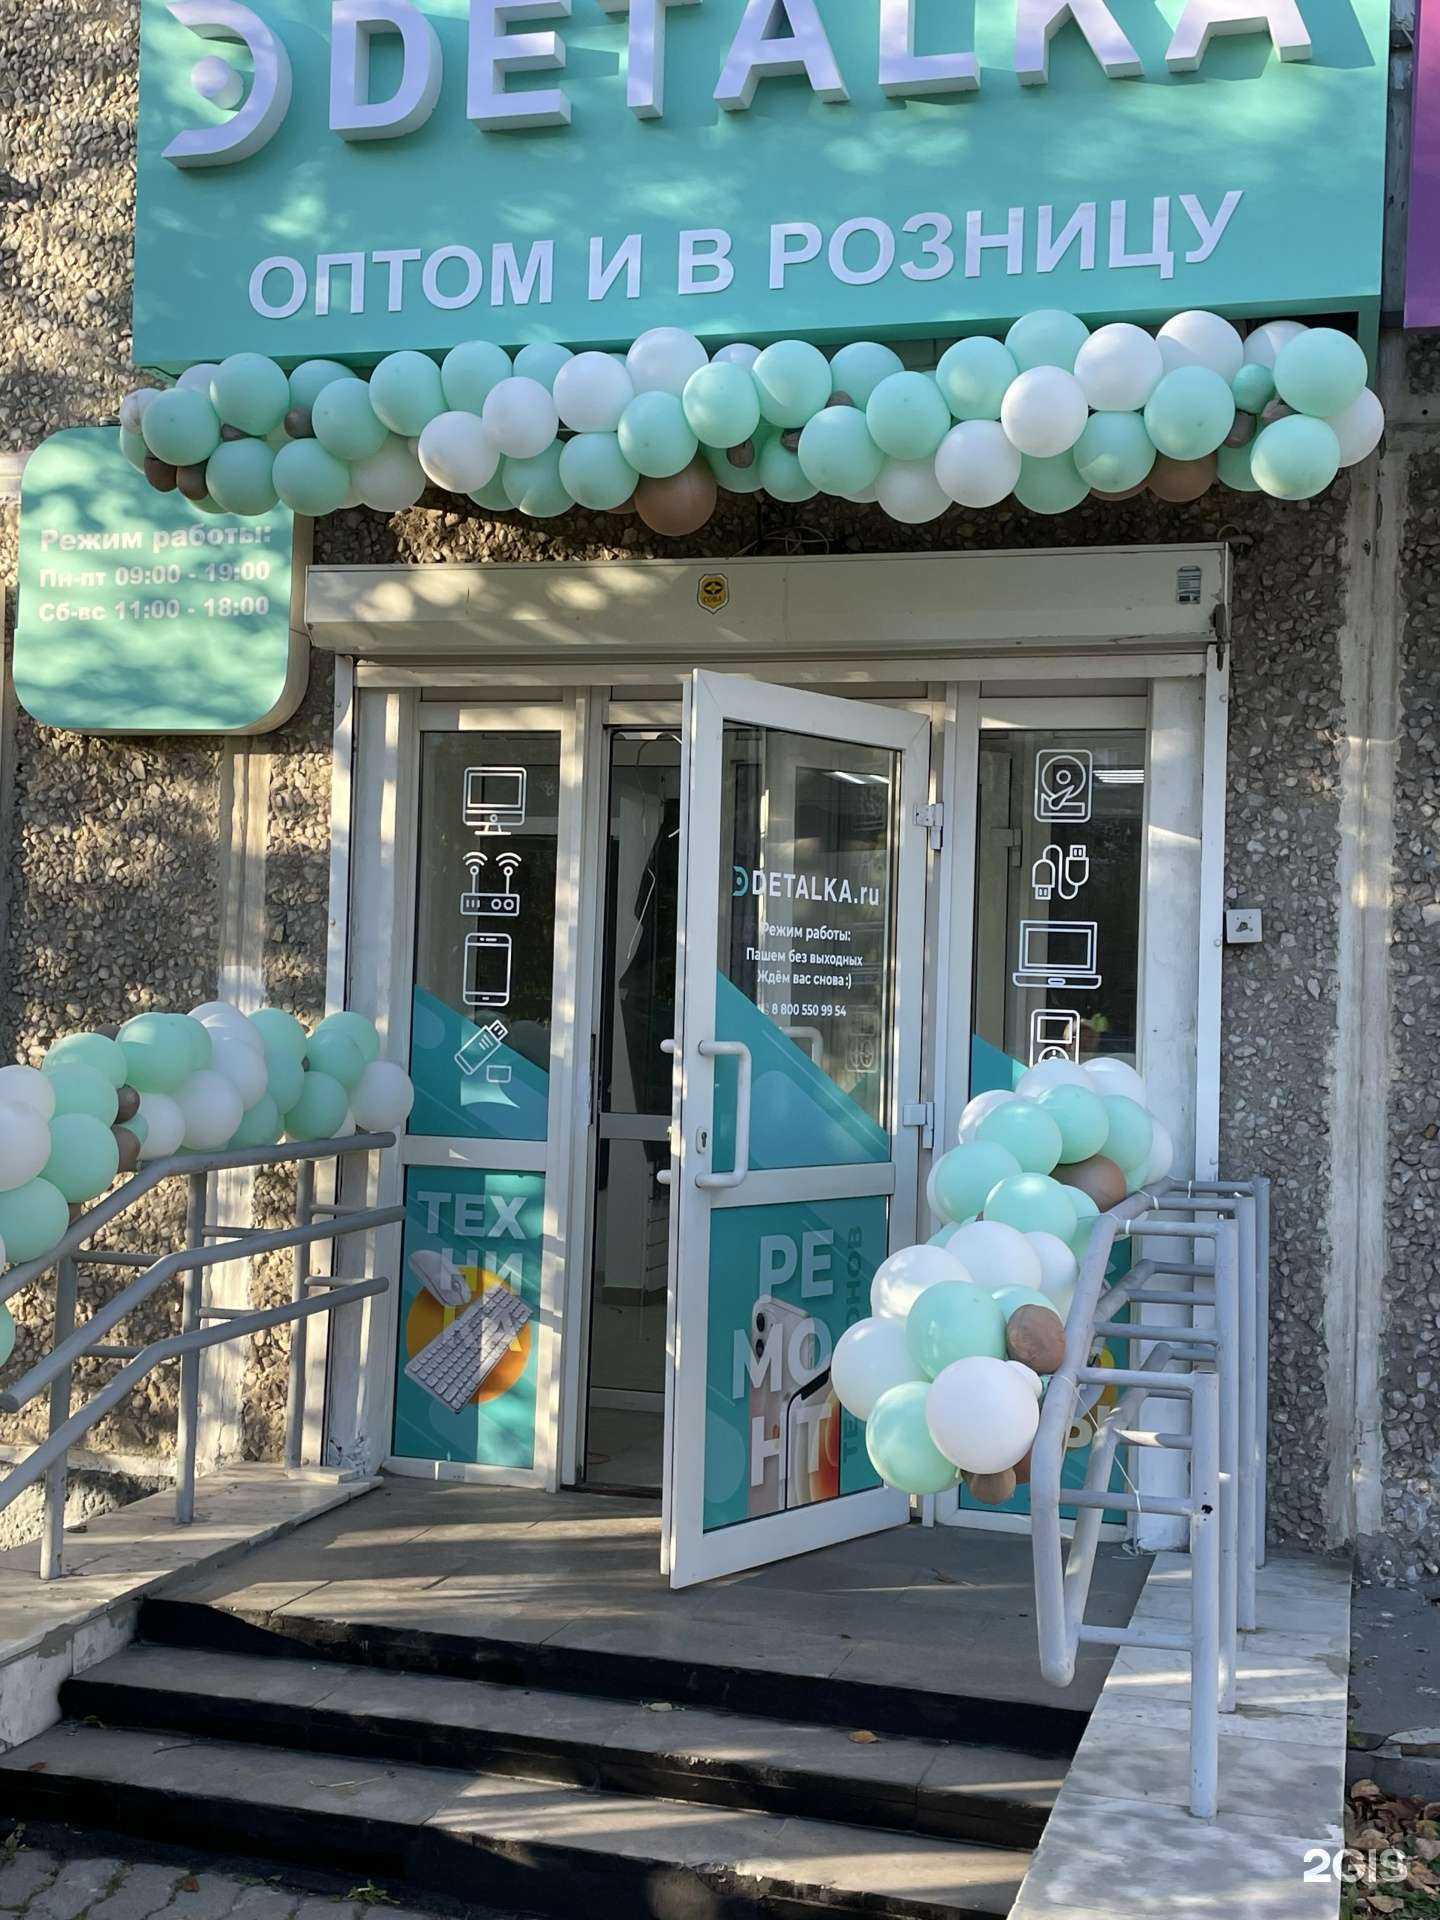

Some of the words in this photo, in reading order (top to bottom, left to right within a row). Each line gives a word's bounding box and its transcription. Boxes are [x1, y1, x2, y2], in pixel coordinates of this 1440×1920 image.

[248, 239, 555, 319] ОПТОМ
[587, 233, 642, 301] И
[678, 228, 735, 295] В
[768, 190, 1244, 289] РОЗНИЦУ
[40, 528, 143, 552] Режим
[152, 524, 272, 553] работы:
[39, 568, 107, 588] Пн-пт
[115, 564, 181, 586] 09:00
[204, 560, 271, 582] 19:00
[38, 602, 107, 621] Сб-вс
[115, 599, 181, 620] 11:00
[203, 596, 270, 617] 18:00
[752, 869, 880, 906] DETALKA.ru
[761, 922, 803, 938] Режим
[806, 925, 851, 942] работы:
[746, 947, 786, 963] Пашем
[789, 949, 807, 964] без
[810, 954, 863, 967] выходных
[757, 969, 790, 984] Ждём
[793, 973, 811, 985] вас
[771, 1003, 778, 1014] 8
[781, 1003, 799, 1015] 800
[802, 1004, 819, 1016] 550
[821, 1004, 833, 1016] 99
[834, 1004, 847, 1017] 54
[417, 1190, 527, 1240] ТЕХ
[440, 1247, 524, 1296] НИ
[759, 1229, 834, 1301] РЕ
[732, 1316, 833, 1400] МО
[750, 1402, 832, 1488] НТ
